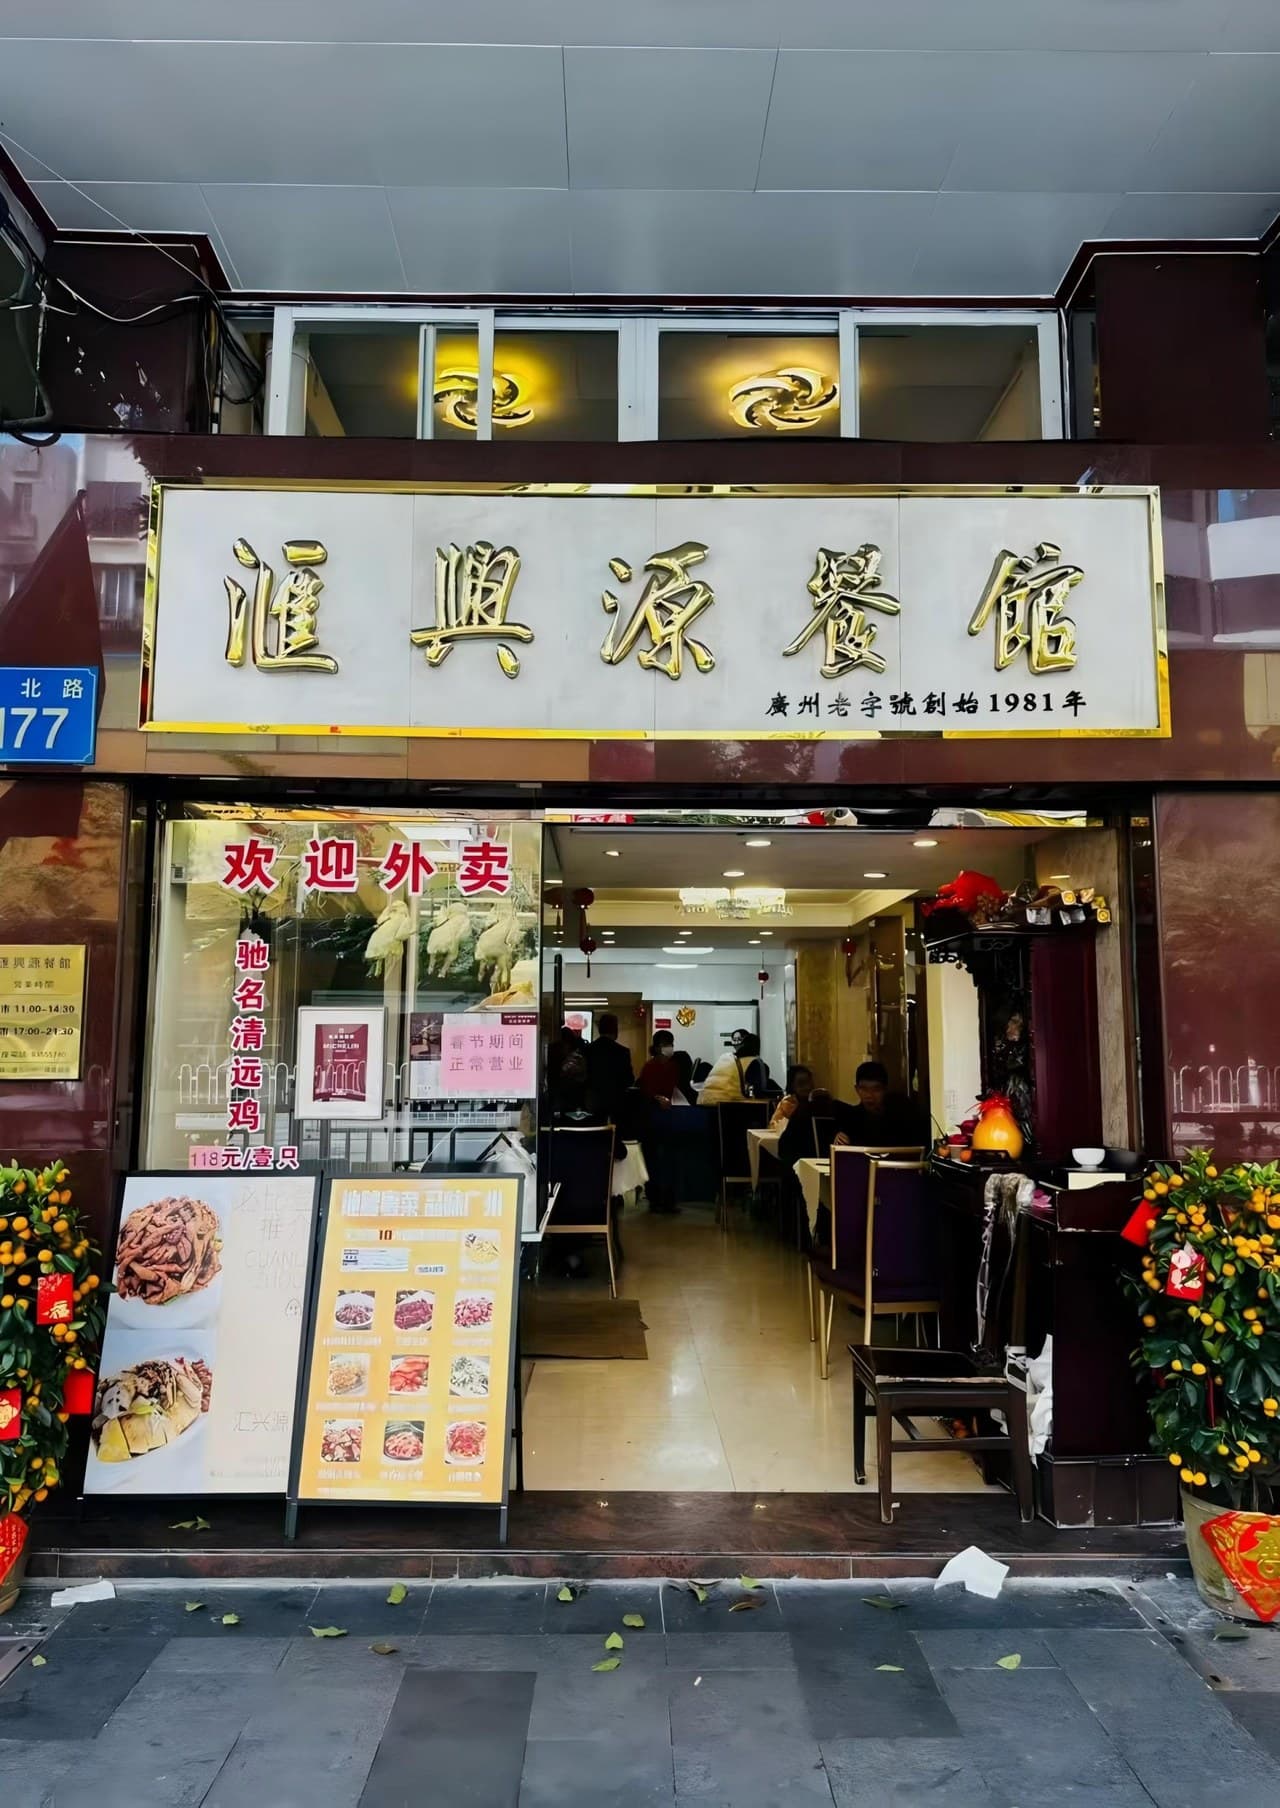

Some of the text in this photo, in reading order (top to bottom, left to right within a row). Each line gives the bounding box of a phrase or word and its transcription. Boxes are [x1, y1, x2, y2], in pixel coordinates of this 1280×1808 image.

[222, 838, 510, 893] 欢迎外卖
[15, 1004, 75, 1014] 11:00-14:30
[13, 1027, 74, 1036] 17:00-21:30
[226, 939, 270, 1132] 驰名清远鸡
